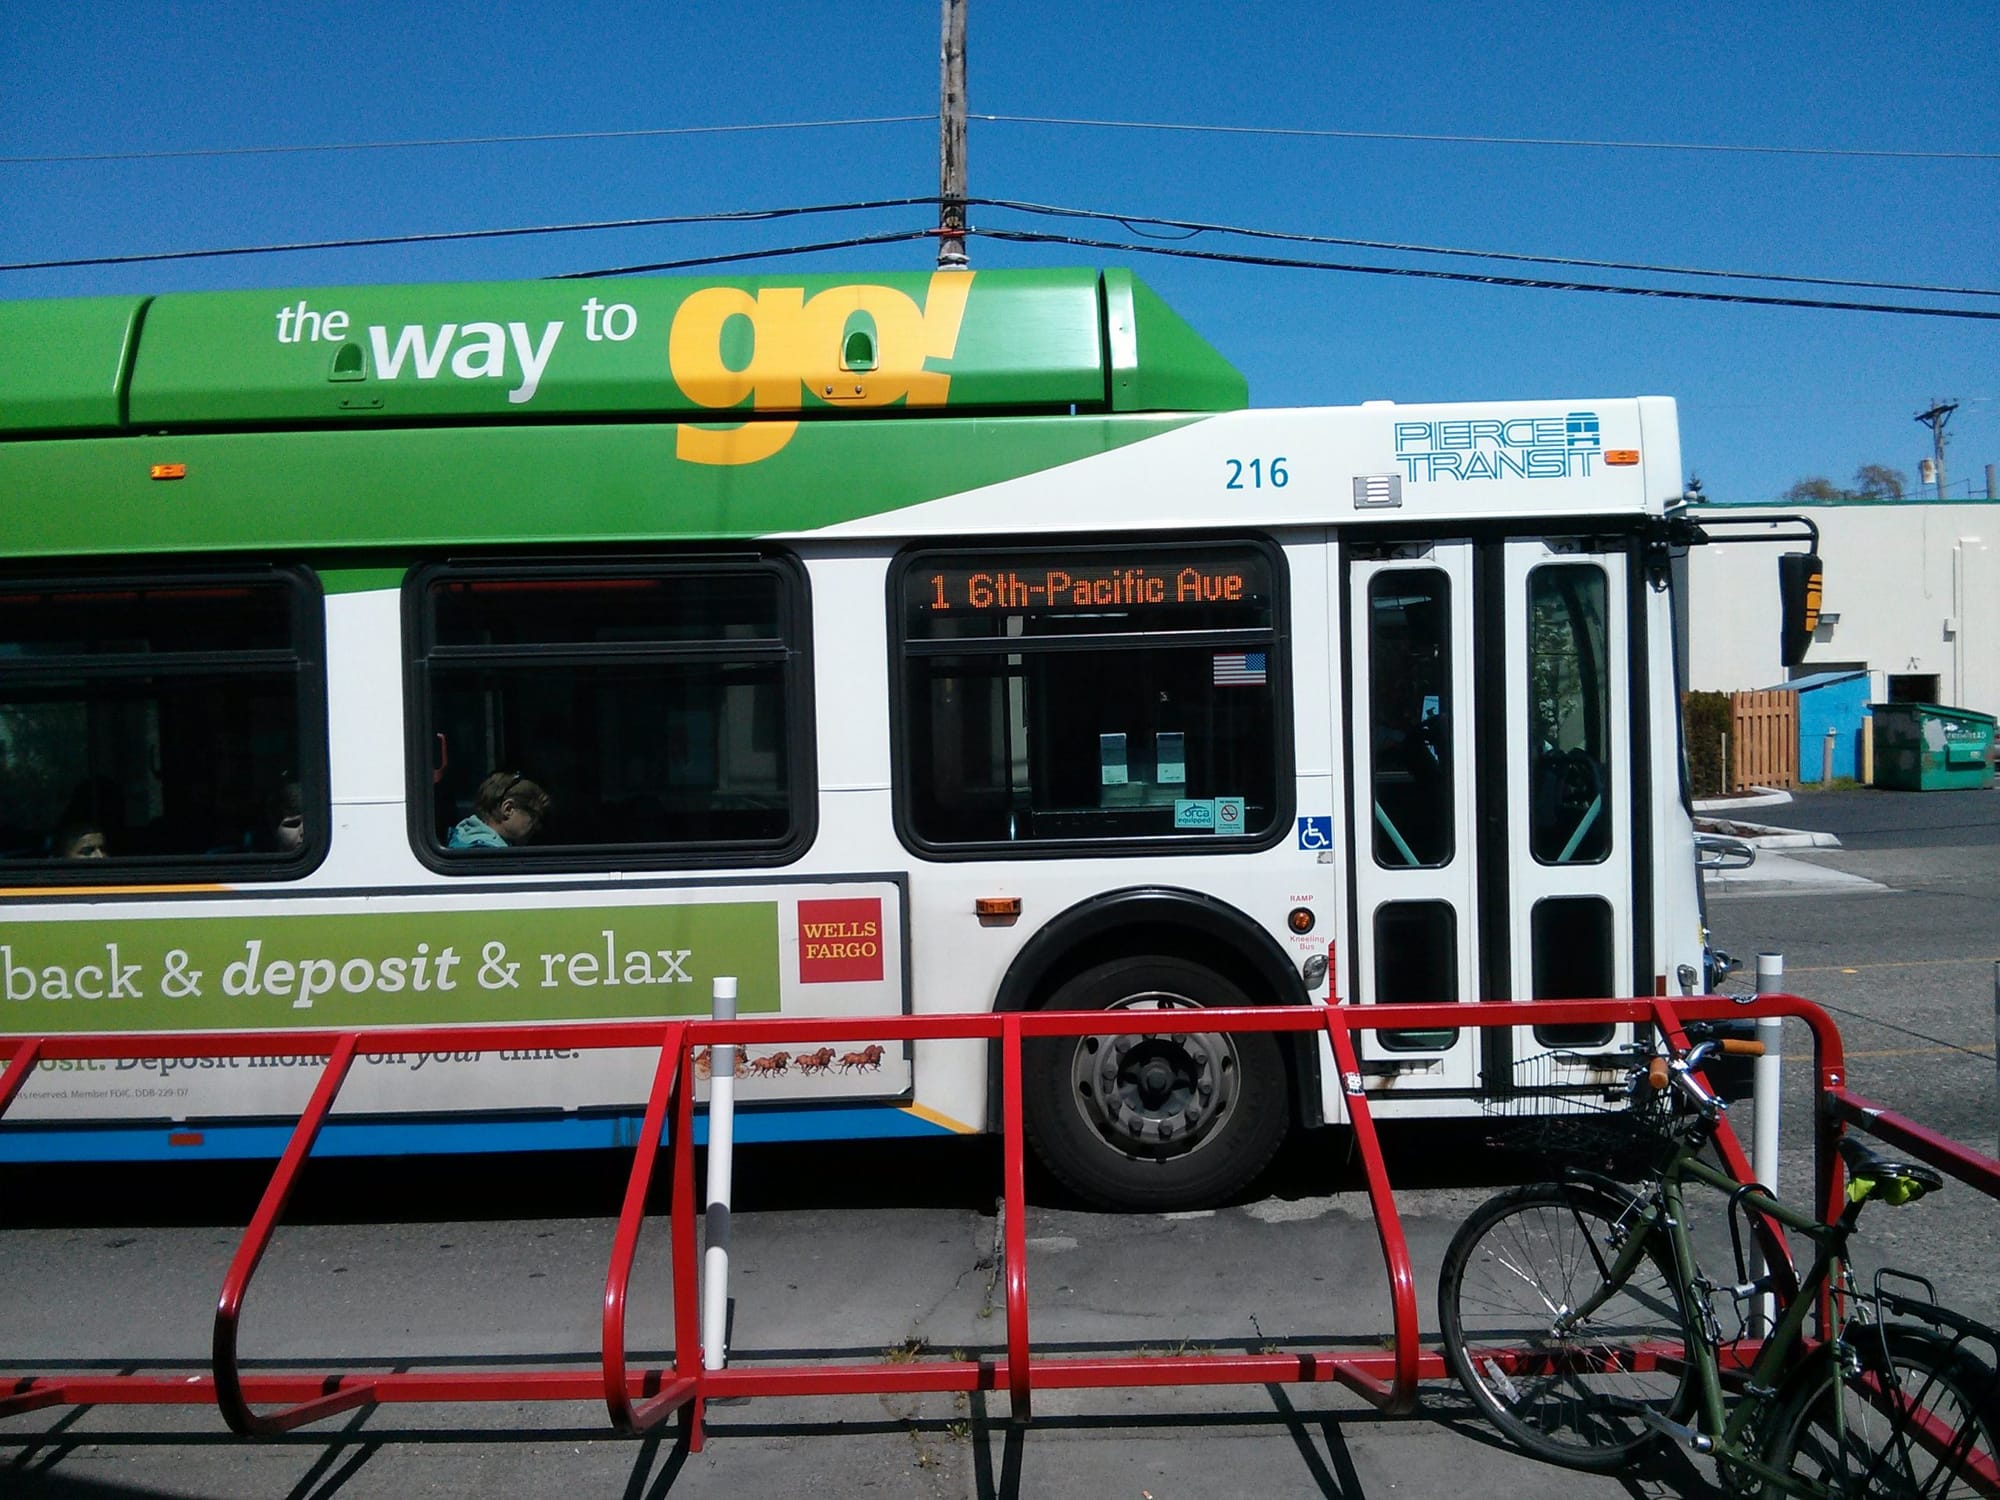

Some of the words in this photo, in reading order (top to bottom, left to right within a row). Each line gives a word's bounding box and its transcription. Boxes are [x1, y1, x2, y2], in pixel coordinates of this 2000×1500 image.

[276, 301, 349, 343] the
[368, 321, 564, 404] way
[581, 297, 638, 341] to
[669, 271, 976, 466] go!
[1394, 417, 1566, 452] PIERCE
[1226, 457, 1289, 489] 216
[1396, 447, 1600, 483] TRANSIT
[931, 575, 950, 609] 1
[968, 568, 1164, 608] 6th-Pacific
[1176, 567, 1243, 602] Ave
[1184, 809, 1210, 818] orca
[803, 921, 877, 939] WELLS
[1290, 936, 1325, 944] Kneeling
[805, 941, 877, 959] FARGO
[0, 943, 143, 1001] back
[160, 949, 203, 998] &
[222, 940, 460, 1009] deposit
[477, 941, 521, 989] &
[540, 930, 693, 987] relax
